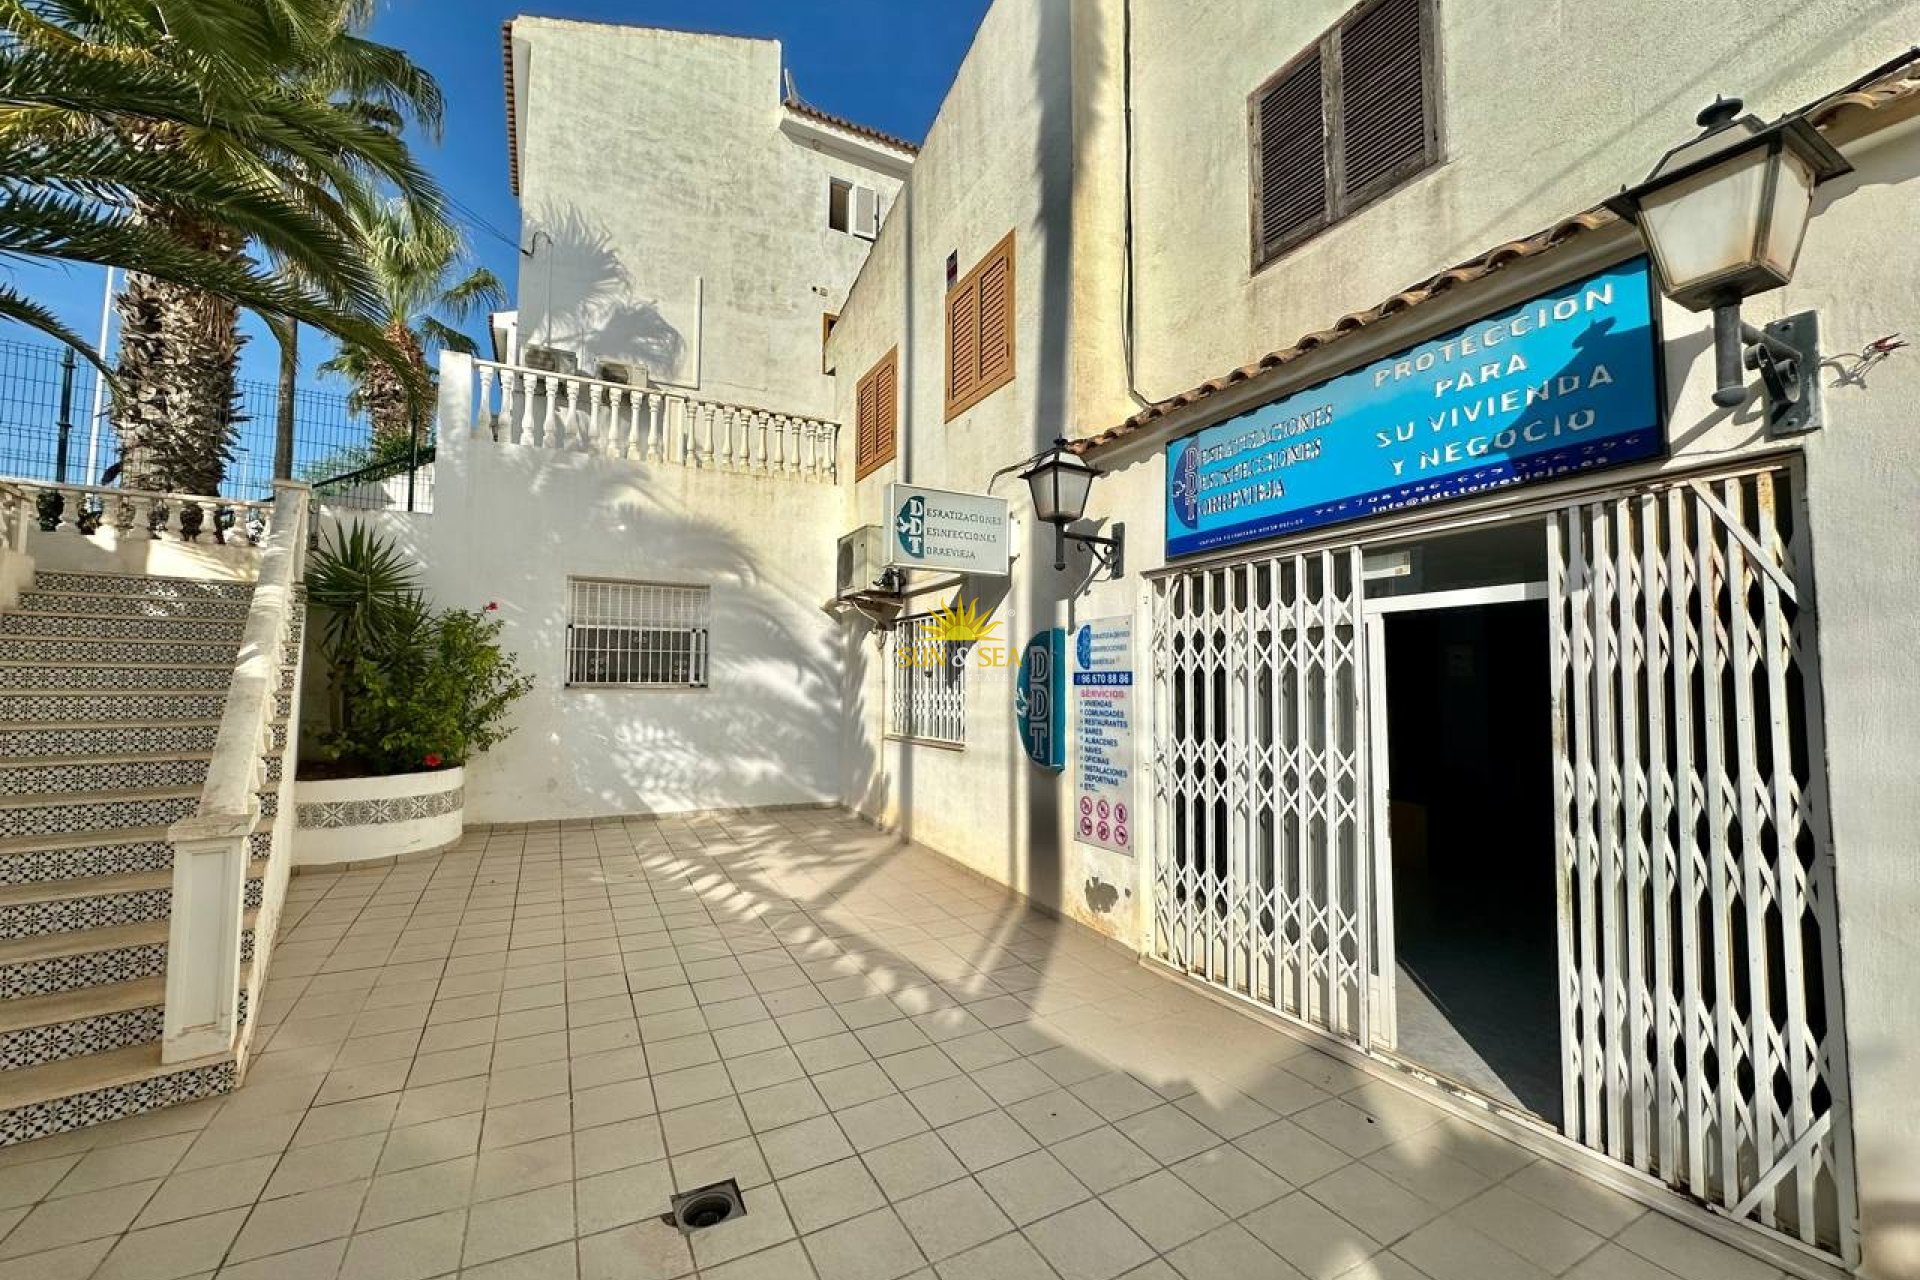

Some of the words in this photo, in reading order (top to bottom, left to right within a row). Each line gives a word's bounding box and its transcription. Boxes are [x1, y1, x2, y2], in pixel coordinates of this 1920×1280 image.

[1374, 283, 1614, 387] PROTECCION
[1435, 354, 1528, 398] PARA
[1376, 421, 1414, 448] SU
[1428, 364, 1614, 432] VIVIENDA
[1391, 458, 1404, 476] Y
[1419, 409, 1596, 470] NEGOCIO
[1029, 645, 1049, 760] DDT
